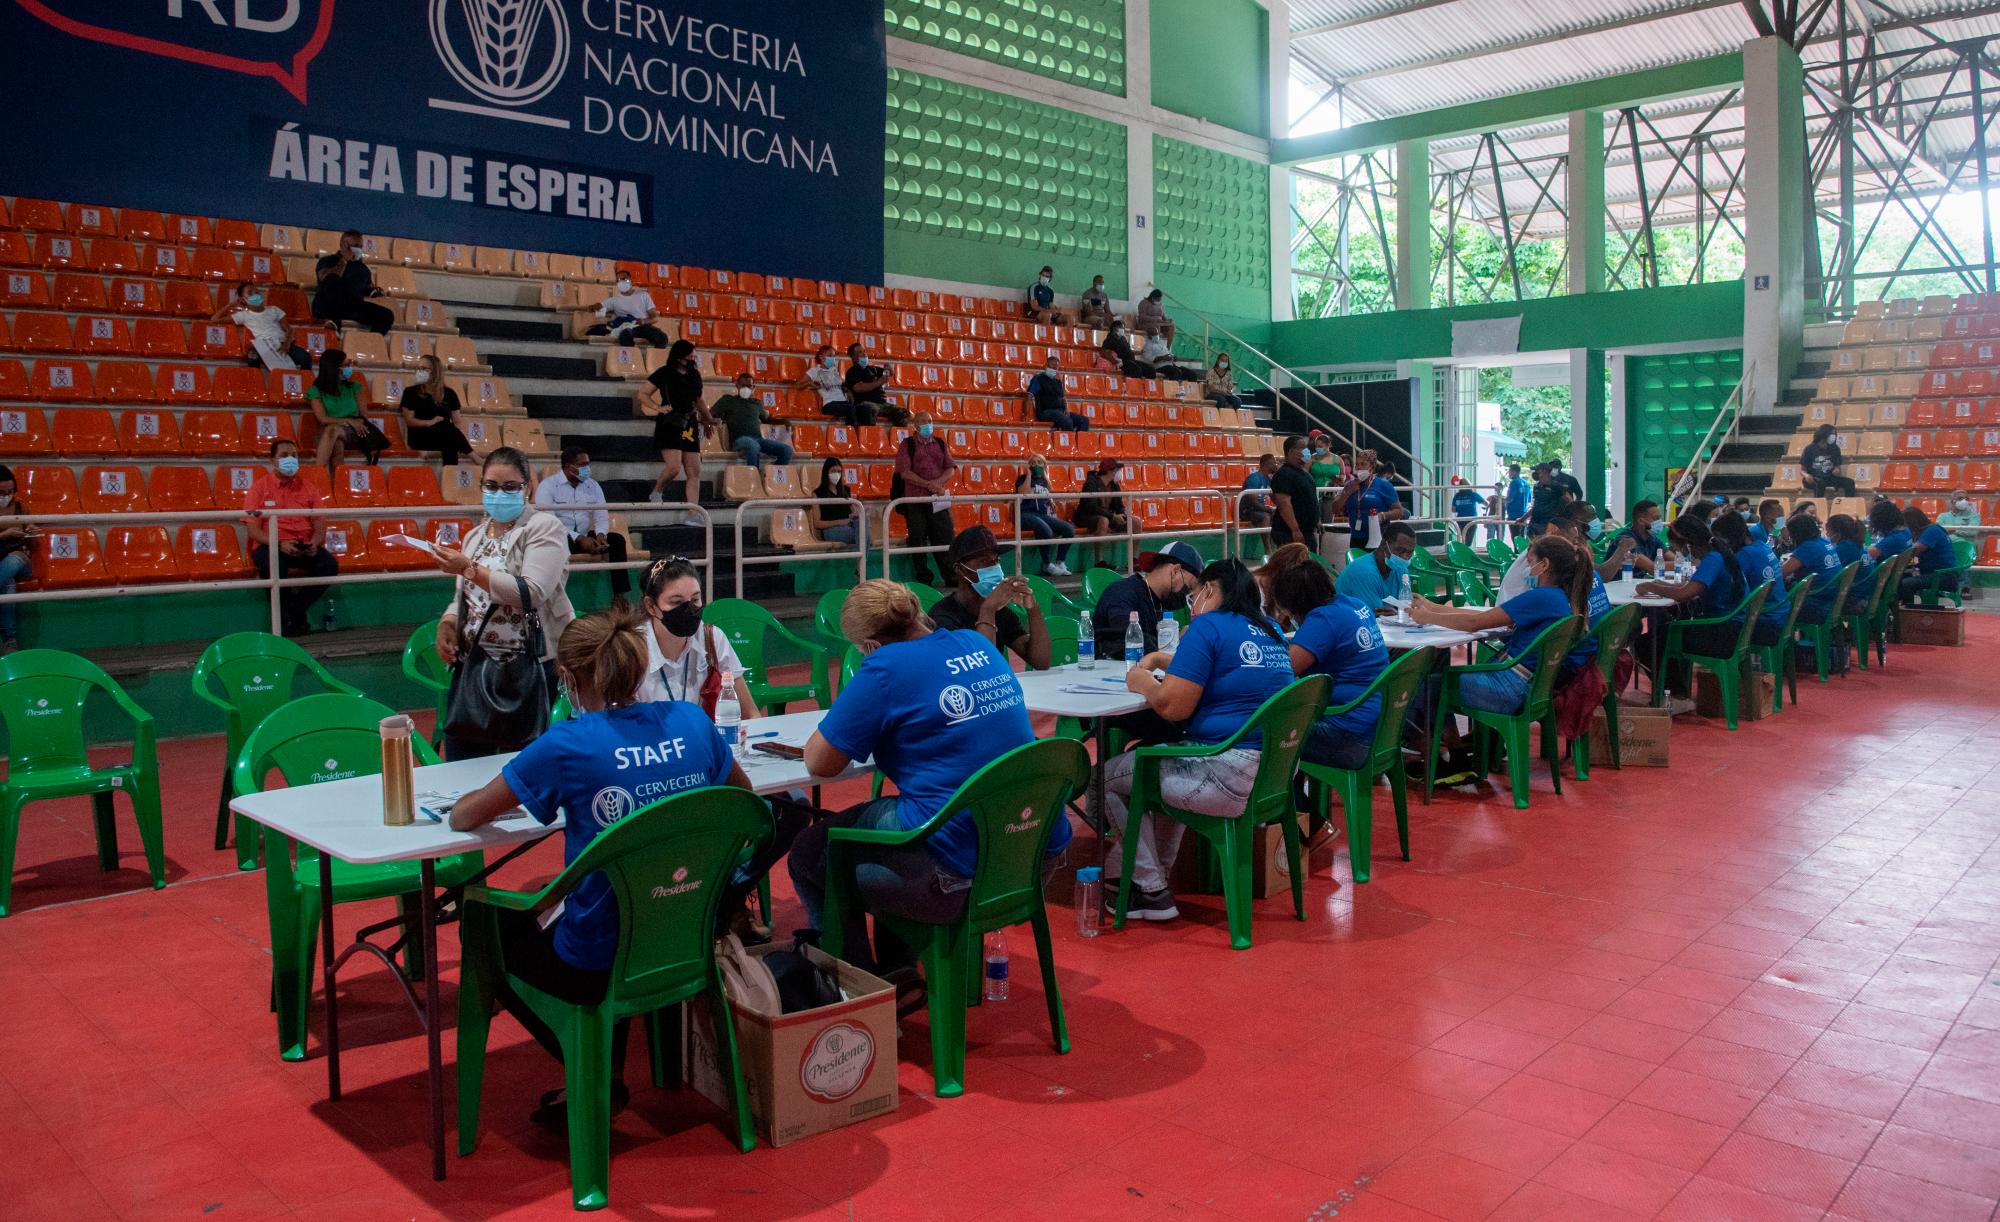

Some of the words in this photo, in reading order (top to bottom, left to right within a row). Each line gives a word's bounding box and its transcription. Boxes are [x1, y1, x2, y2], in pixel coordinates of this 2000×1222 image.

[582, 0, 806, 77] CERVECERIA
[584, 42, 785, 120] NACIONAL
[584, 95, 839, 177] DOMINICANA
[269, 121, 404, 194] ÁREA
[416, 150, 474, 203] DE
[486, 160, 642, 224] ESPERA
[946, 651, 990, 675] STAFF
[971, 673, 1012, 692] CERVECERIA
[976, 685, 1015, 704] NACIONAL
[614, 737, 686, 770] STAFF
[311, 770, 356, 783] Presidente
[635, 772, 706, 797] CERVECERIA
[651, 880, 703, 899] Presidente
[809, 1042, 865, 1080] Presidente
